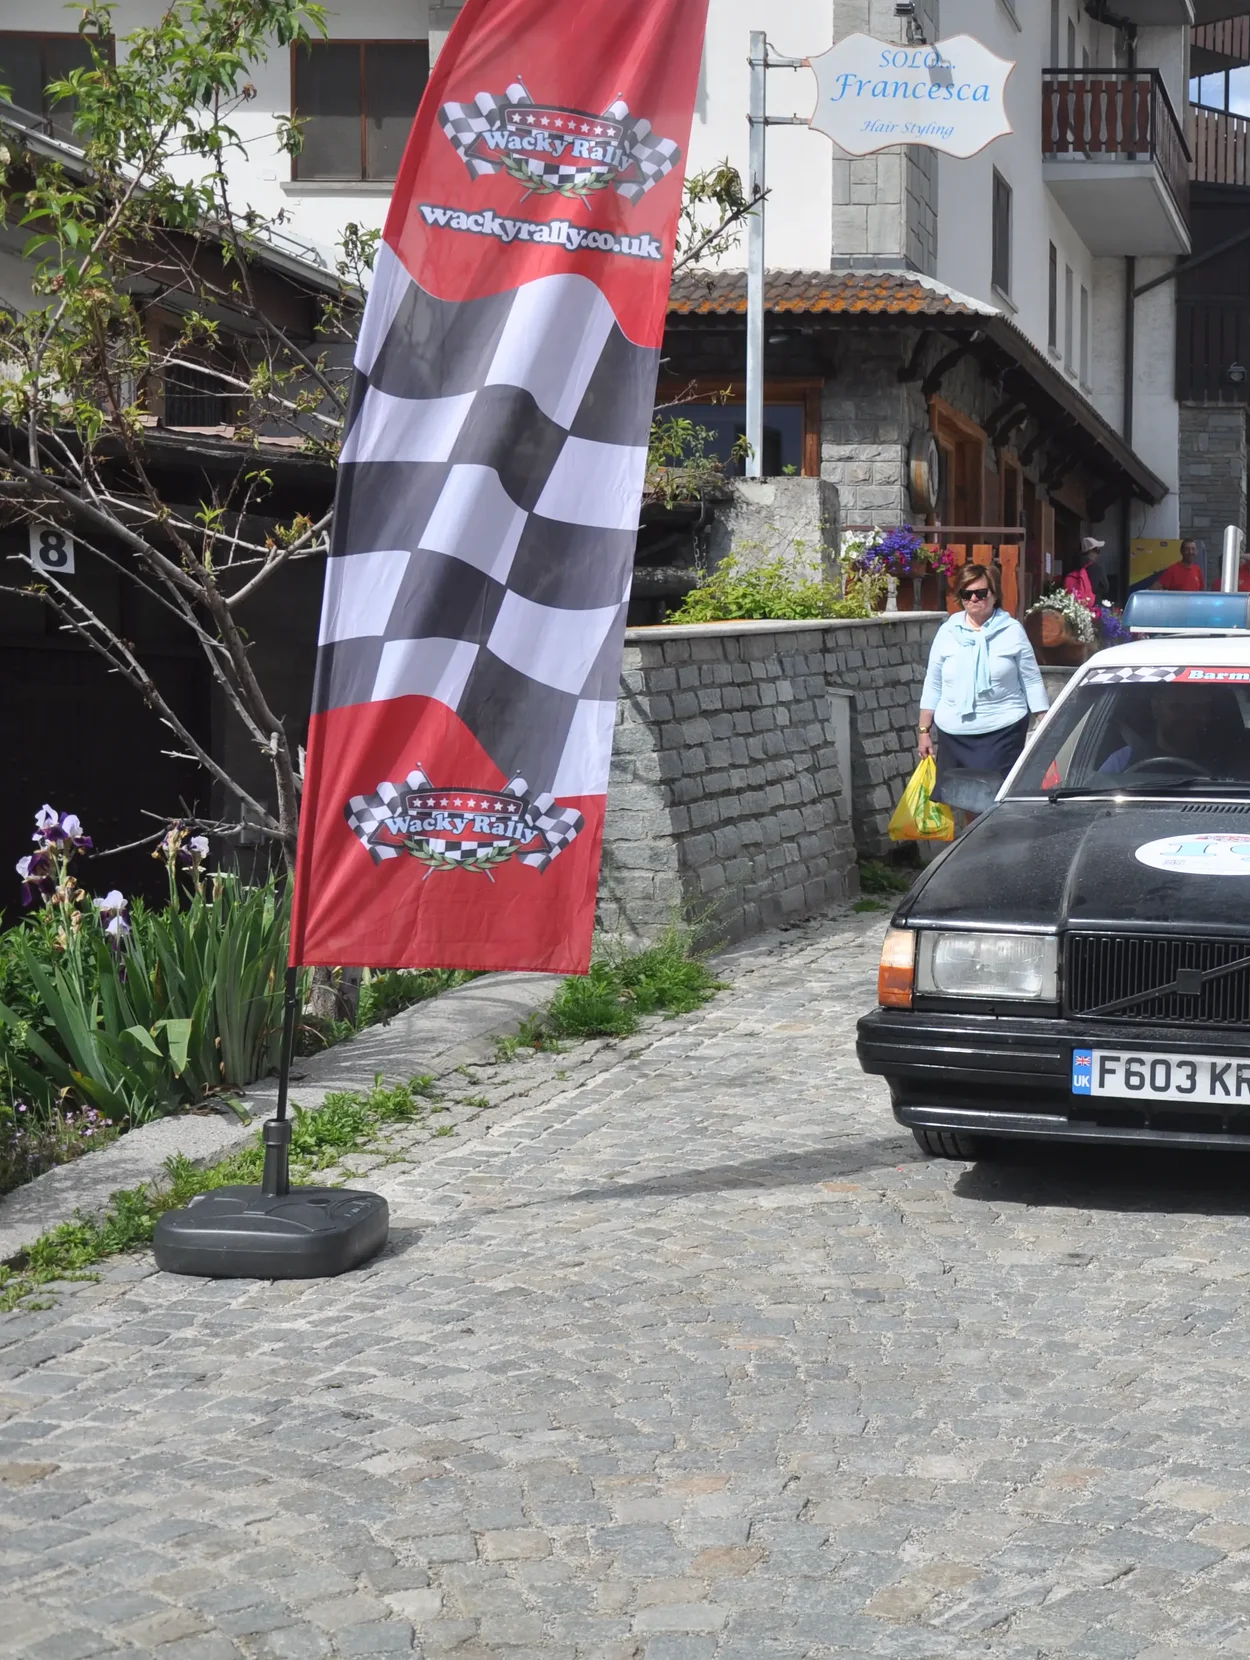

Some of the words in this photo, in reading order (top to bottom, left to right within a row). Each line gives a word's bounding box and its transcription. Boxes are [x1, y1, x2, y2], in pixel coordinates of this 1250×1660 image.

[830, 73, 991, 102] Francesca
[860, 119, 899, 133] Hair
[901, 120, 955, 139] Styling
[480, 129, 570, 157] Wacky
[571, 138, 633, 172] Rally
[419, 205, 662, 259] wackyrally.co.uk
[39, 529, 68, 567] 8
[384, 813, 469, 836] Wacky
[472, 815, 539, 844] Rally
[1073, 1074, 1090, 1087] UK
[1098, 1055, 1197, 1094] F603
